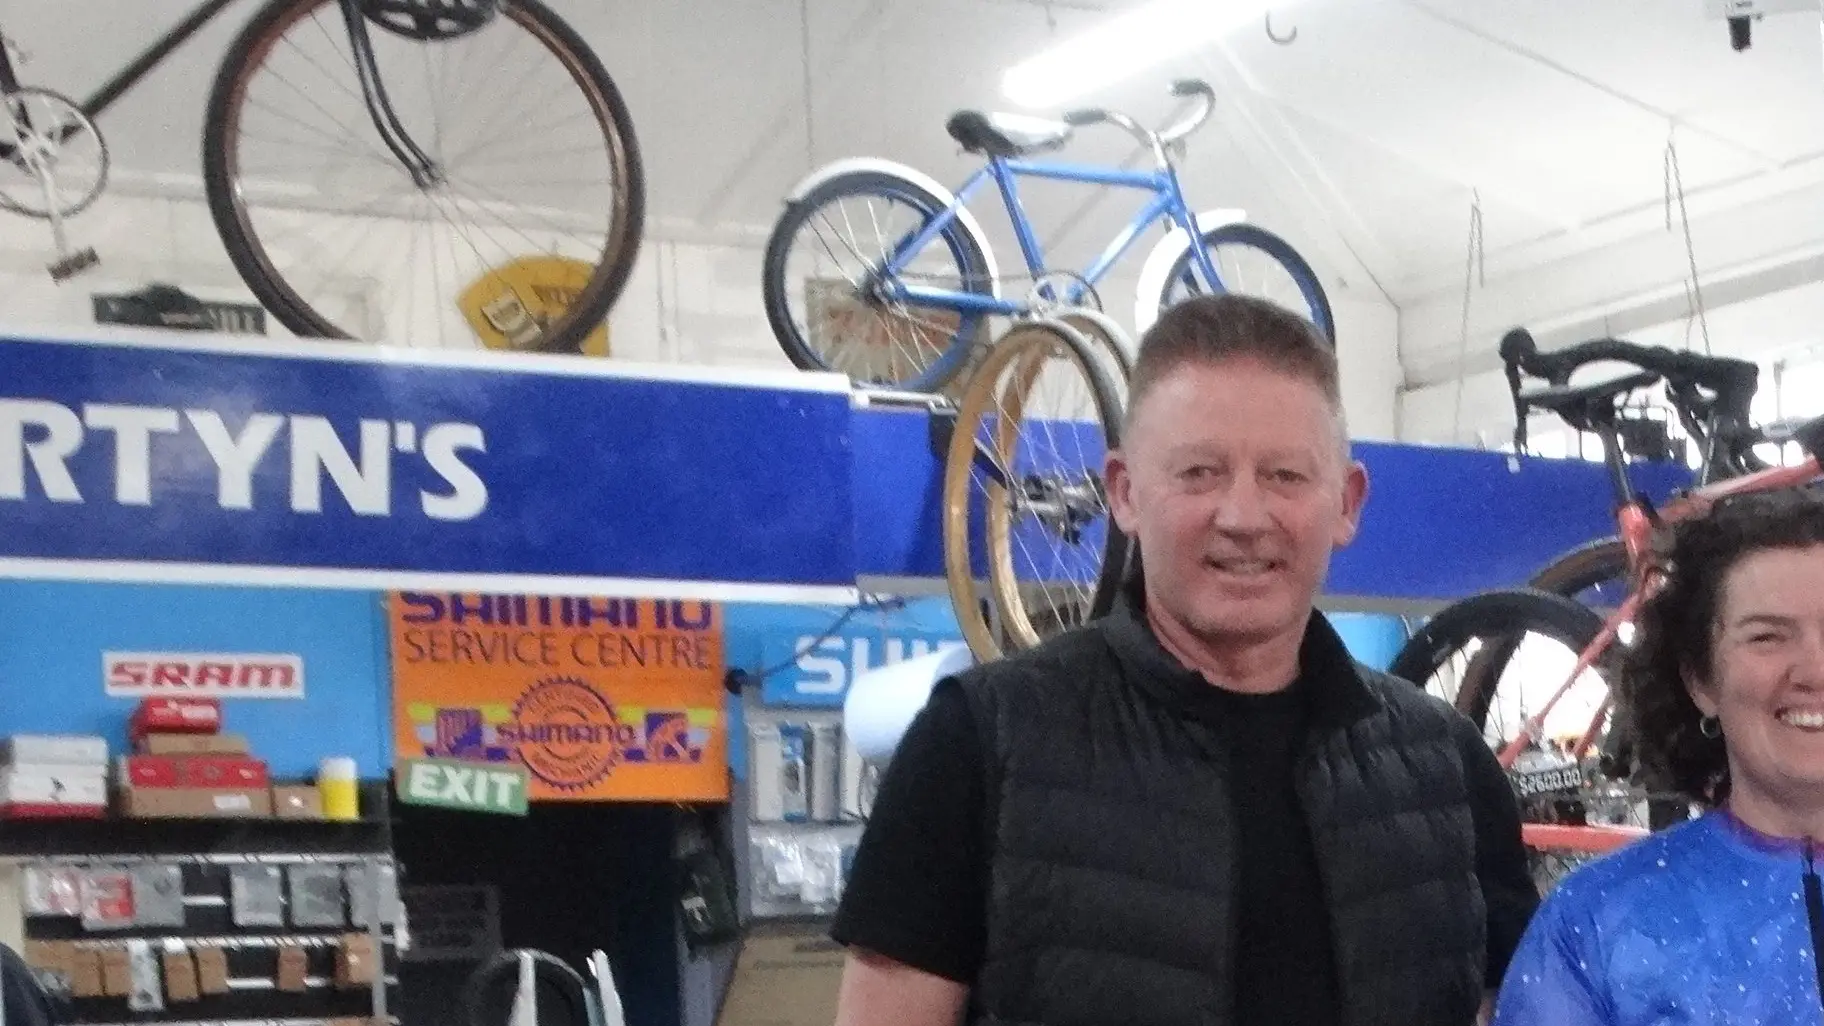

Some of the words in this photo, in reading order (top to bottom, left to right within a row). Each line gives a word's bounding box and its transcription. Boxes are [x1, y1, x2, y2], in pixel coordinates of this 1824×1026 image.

[0, 397, 489, 522] RTYN'S
[402, 629, 561, 668] SERVICE
[569, 632, 714, 669] CENTRE
[109, 661, 295, 690] SRAM
[496, 722, 635, 747] SHIMANO
[408, 763, 521, 810] EXIT
